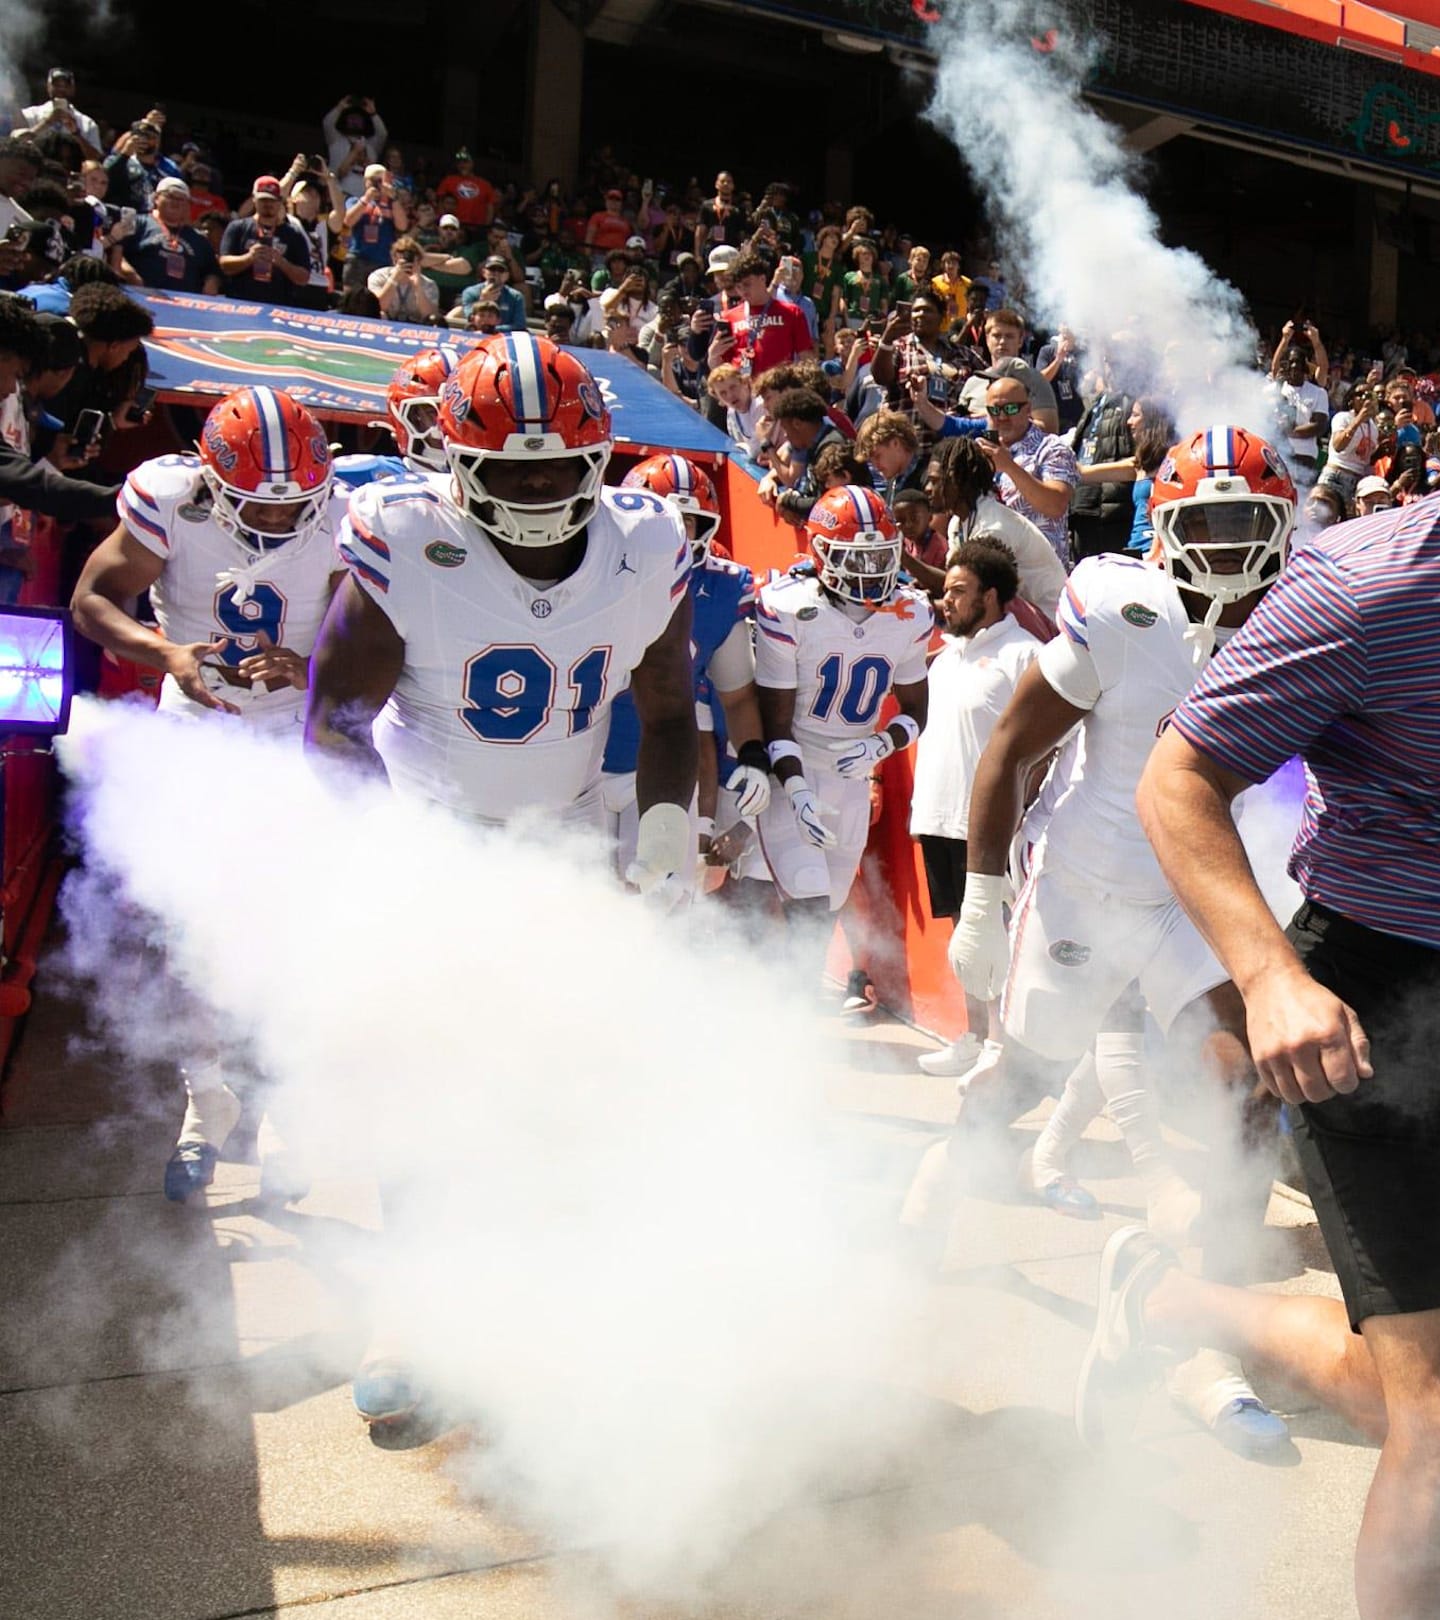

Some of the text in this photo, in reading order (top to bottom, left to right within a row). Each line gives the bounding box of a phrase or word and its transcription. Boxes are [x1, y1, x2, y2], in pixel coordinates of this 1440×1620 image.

[209, 580, 288, 668] 9
[457, 643, 612, 744] 91
[808, 652, 894, 725] 10
